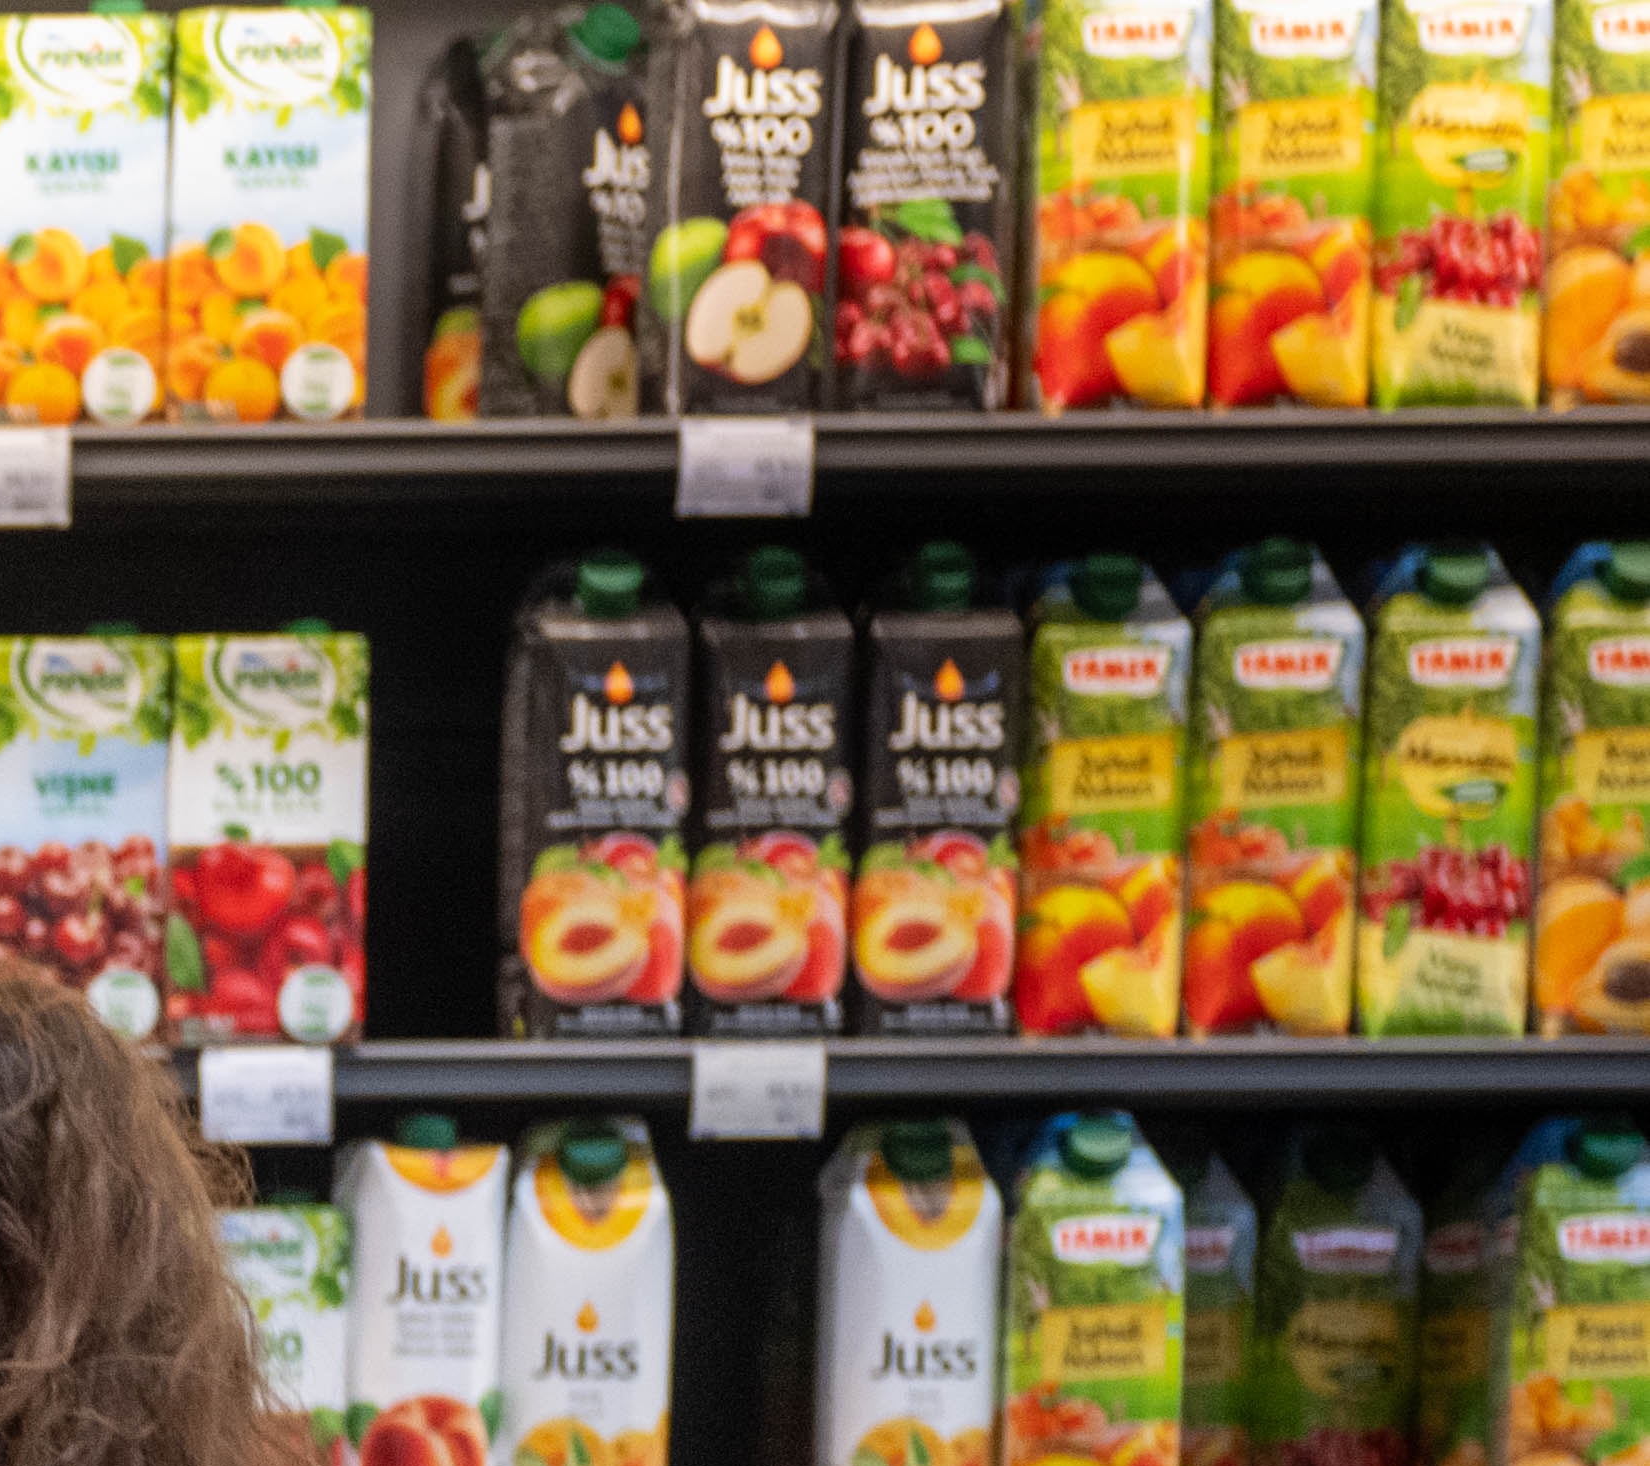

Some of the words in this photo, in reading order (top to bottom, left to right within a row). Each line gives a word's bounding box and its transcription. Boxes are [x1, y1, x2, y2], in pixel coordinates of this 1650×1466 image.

[703, 54, 823, 116] Juss
[863, 53, 986, 116] Juss
[712, 115, 813, 156] %100
[870, 112, 975, 153] %100
[26, 149, 119, 176] KAYISI
[224, 146, 318, 172] KAYISI
[560, 693, 674, 753] Juss
[719, 693, 836, 753] Juss
[889, 692, 1005, 751] Juss
[215, 763, 321, 796] %100
[568, 760, 664, 798] %100
[727, 759, 825, 797] %100
[896, 759, 995, 797] %100
[388, 1256, 488, 1305] Juss
[530, 1330, 639, 1381] Juss
[872, 1330, 977, 1381] Juss
